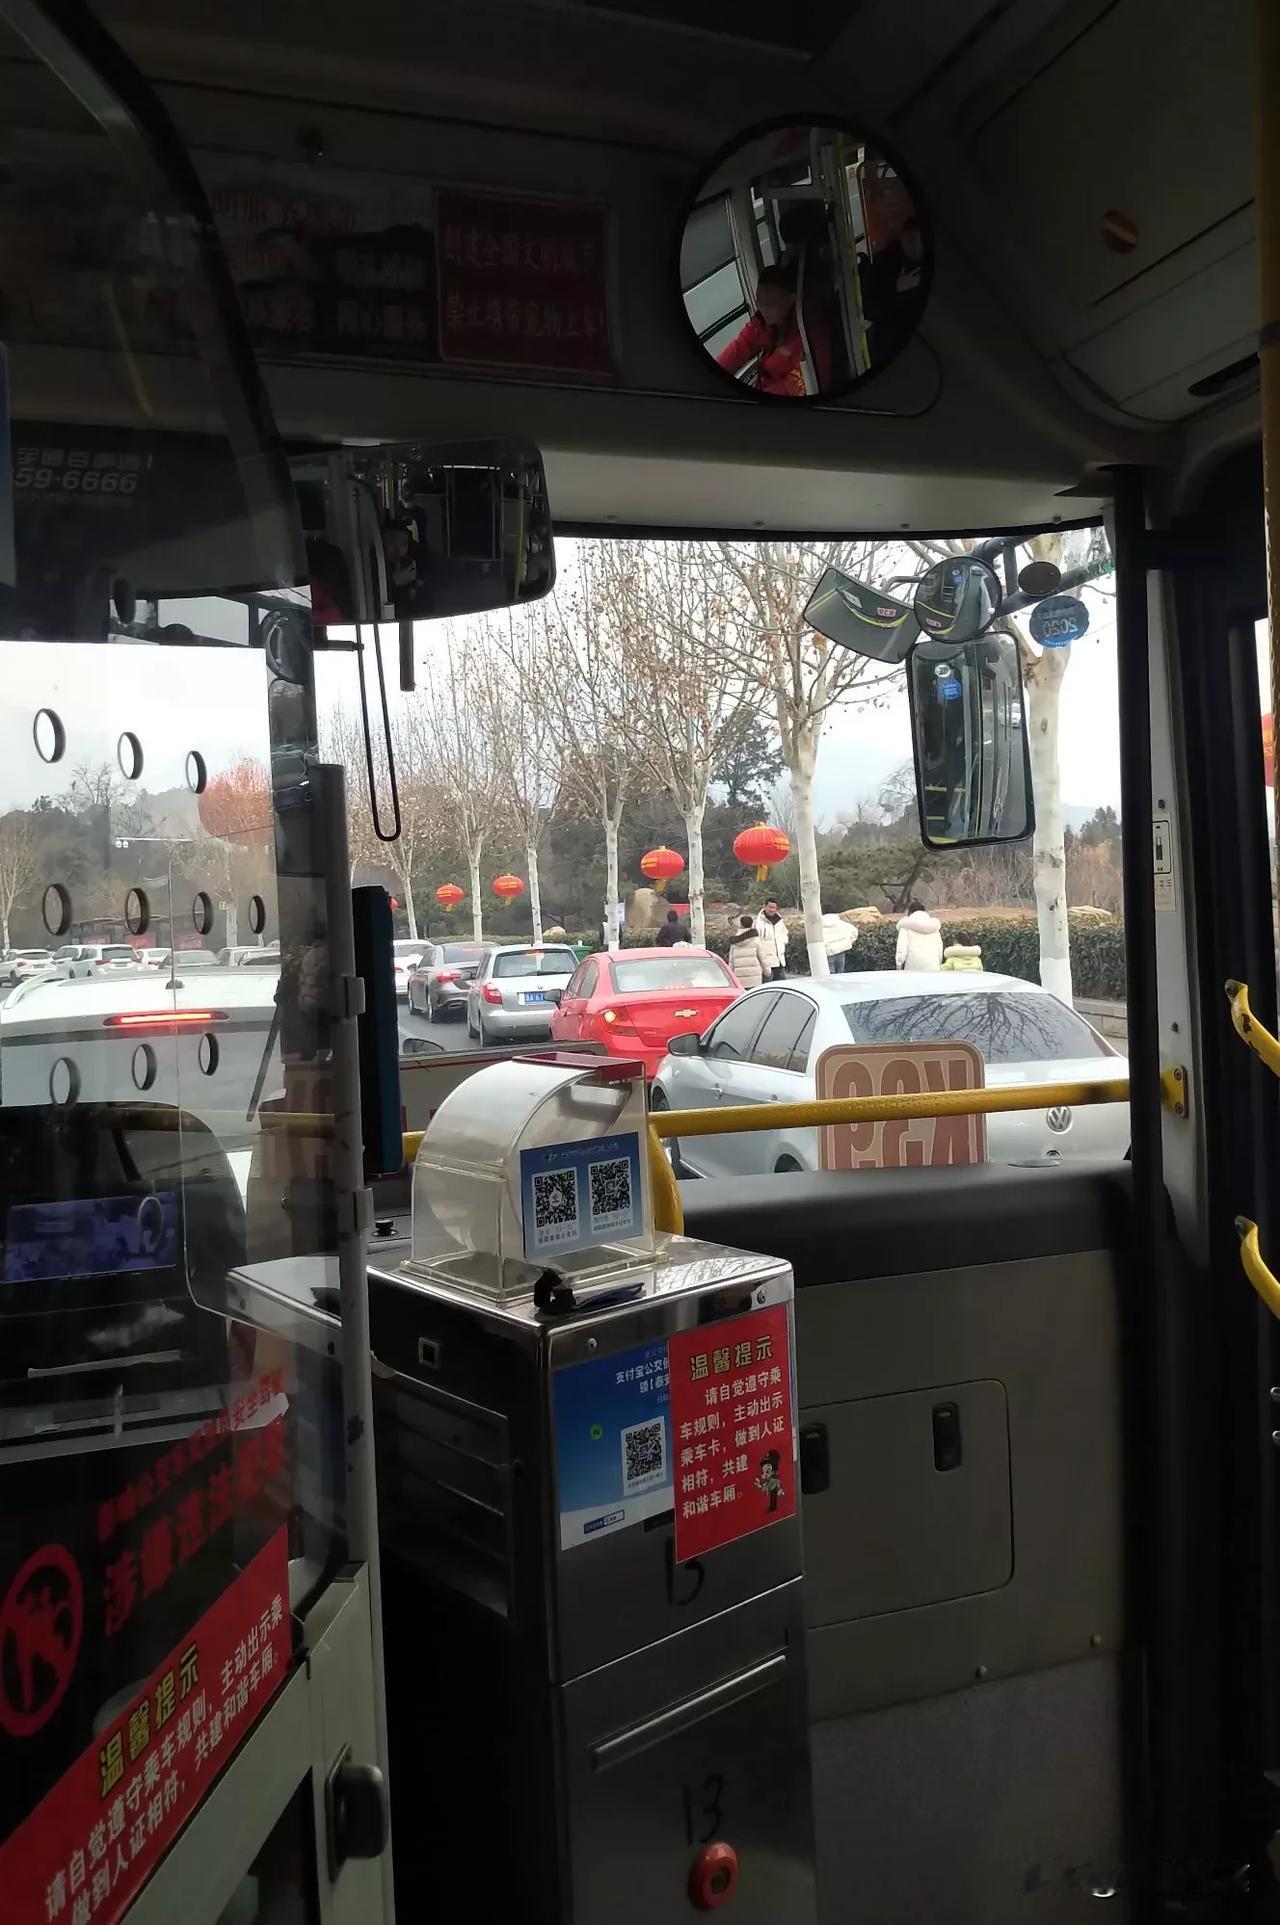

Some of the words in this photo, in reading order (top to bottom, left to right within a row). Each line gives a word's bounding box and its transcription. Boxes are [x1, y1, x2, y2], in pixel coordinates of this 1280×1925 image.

[690, 1335, 773, 1381] 温馨提示
[704, 1367, 782, 1406] 请自觉遵守乘
[680, 1391, 784, 1440] 车规则，主动出示
[680, 1416, 785, 1468] 乘车卡，做到人证
[681, 1453, 749, 1494] 相符，共建
[682, 1484, 743, 1519] 和谐车厢。
[98, 1639, 200, 1800] 温馨提示
[682, 1775, 723, 1847] 13
